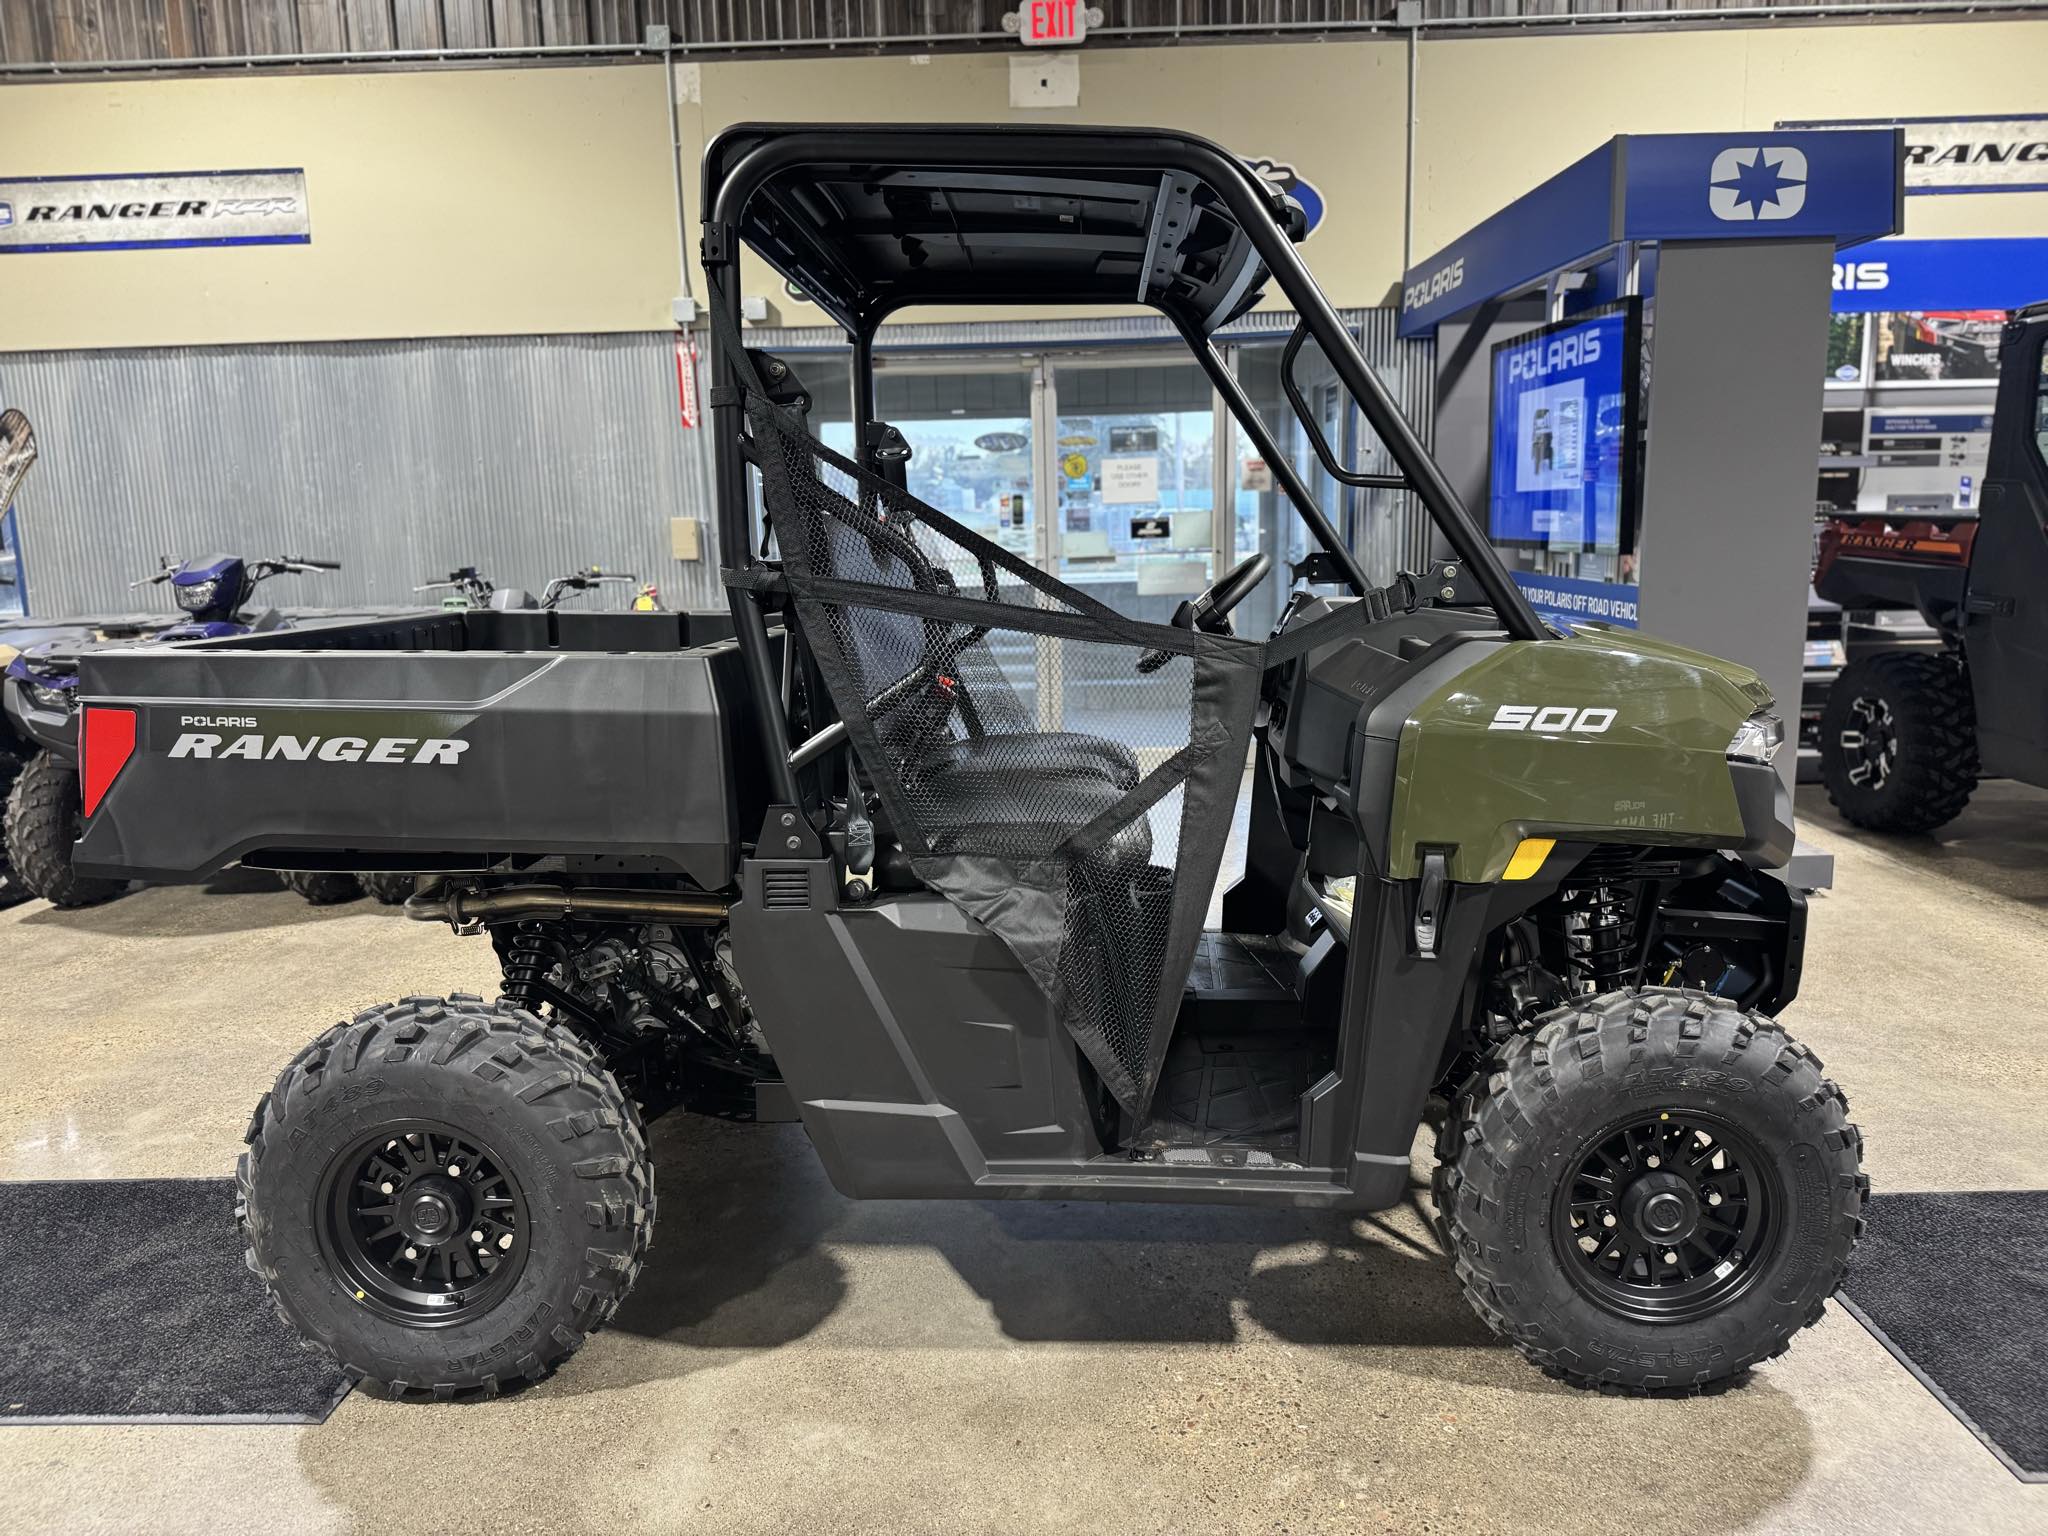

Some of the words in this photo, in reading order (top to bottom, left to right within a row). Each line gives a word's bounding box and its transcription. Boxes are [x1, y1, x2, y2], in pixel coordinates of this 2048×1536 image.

[1031, 0, 1077, 39] EXIT
[1904, 143, 2048, 165] RANG
[26, 201, 208, 221] RANGER
[1403, 257, 1464, 314] POLARIS
[1509, 328, 1601, 384] POLARIS
[1891, 353, 1941, 366] WINCHES
[1528, 587, 1544, 605] YOUR
[1544, 590, 1573, 610] POLARIS
[1573, 594, 1587, 613] OFF
[1588, 597, 1609, 616] ROAD
[181, 716, 257, 728] POLARIS
[1488, 705, 1618, 732] 500
[168, 733, 470, 765] RANGER
